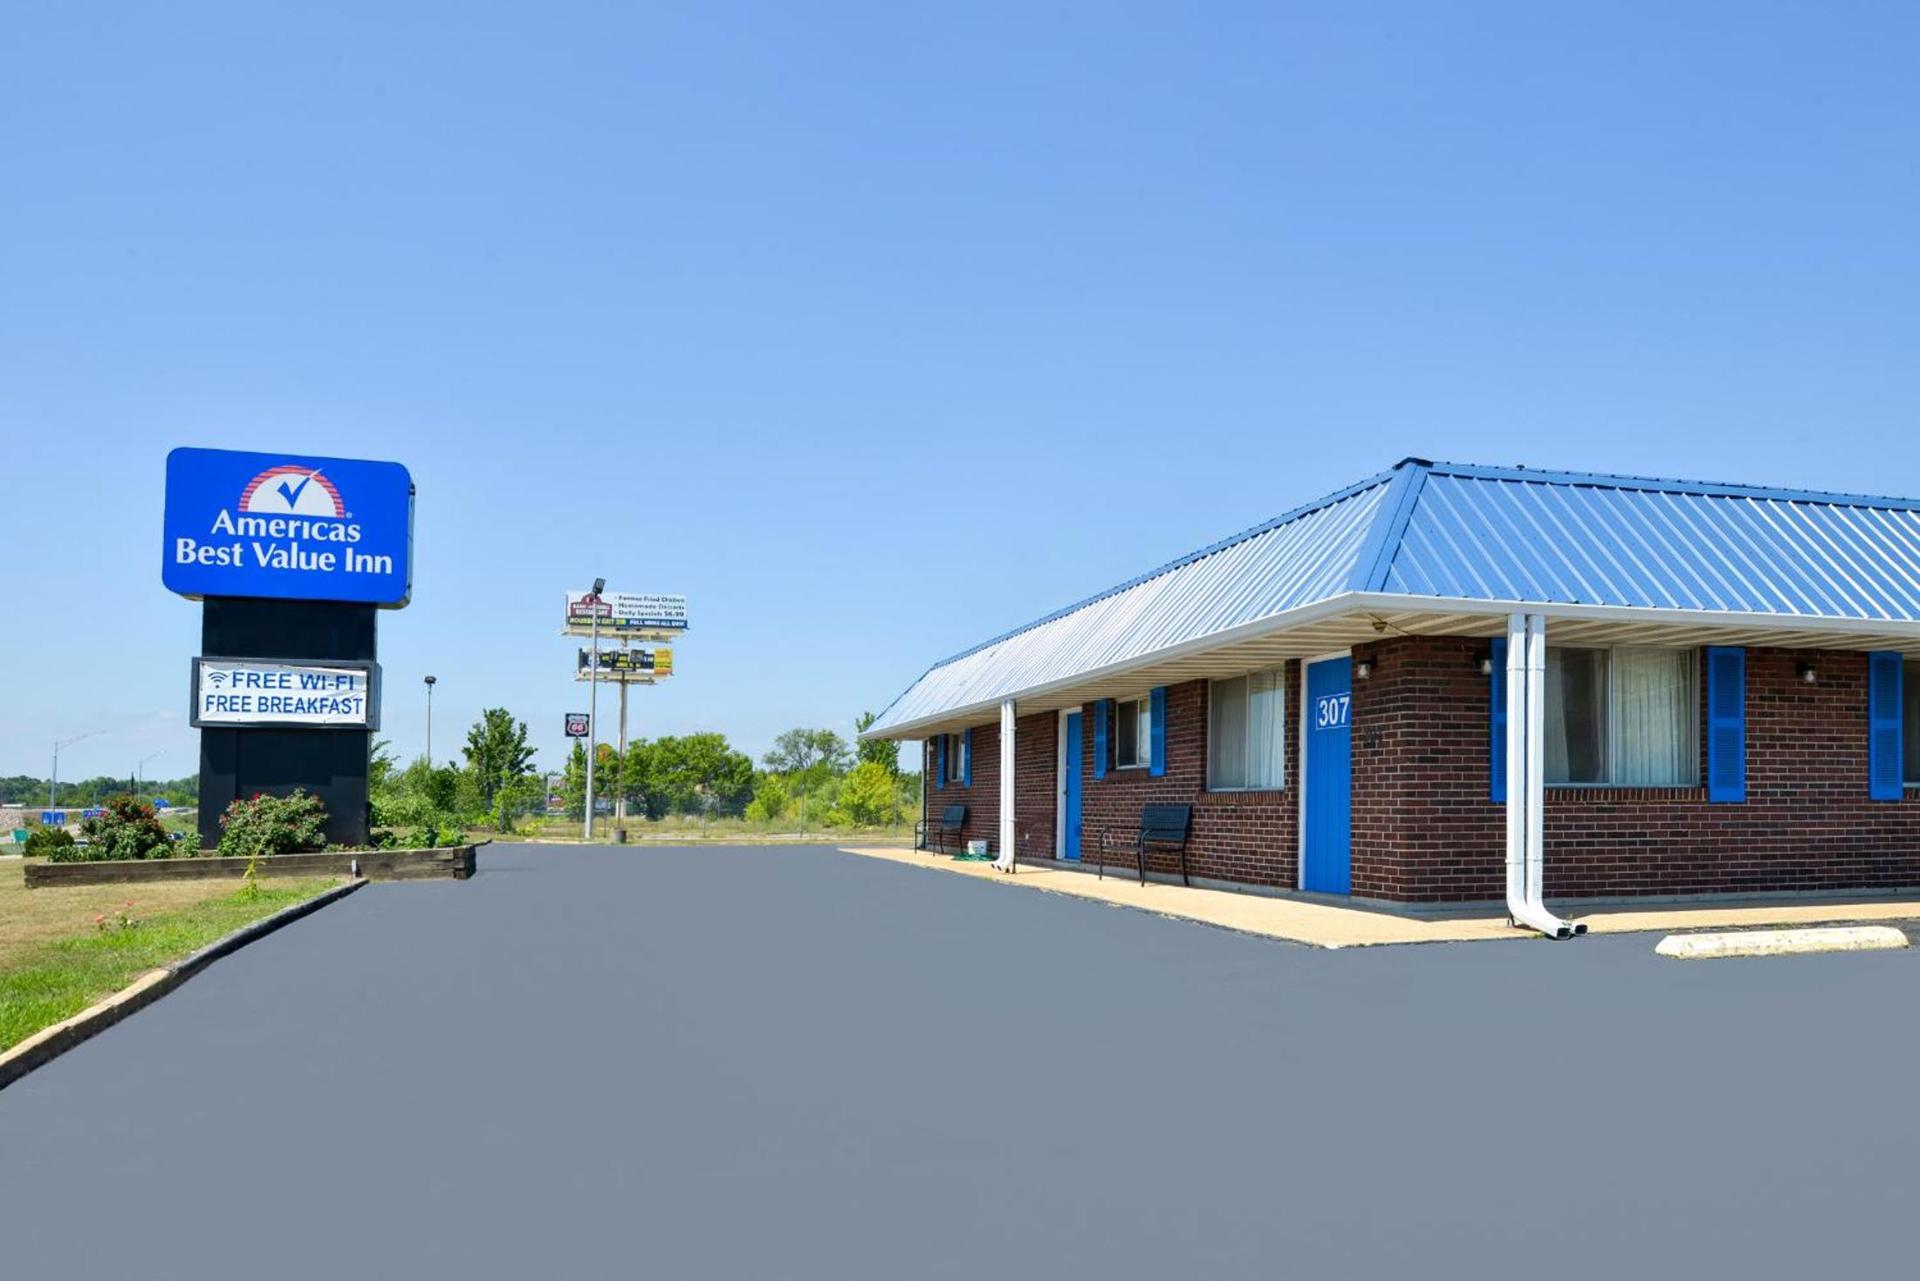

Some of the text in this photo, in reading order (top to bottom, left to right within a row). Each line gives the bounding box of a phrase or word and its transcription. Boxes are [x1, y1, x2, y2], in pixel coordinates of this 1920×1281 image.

[211, 509, 361, 542] Americas
[176, 538, 392, 575] Best Value Inn
[232, 671, 354, 690] FREE WI-FI
[205, 695, 363, 715] FREE BREAKFAST
[1319, 696, 1350, 726] 307
